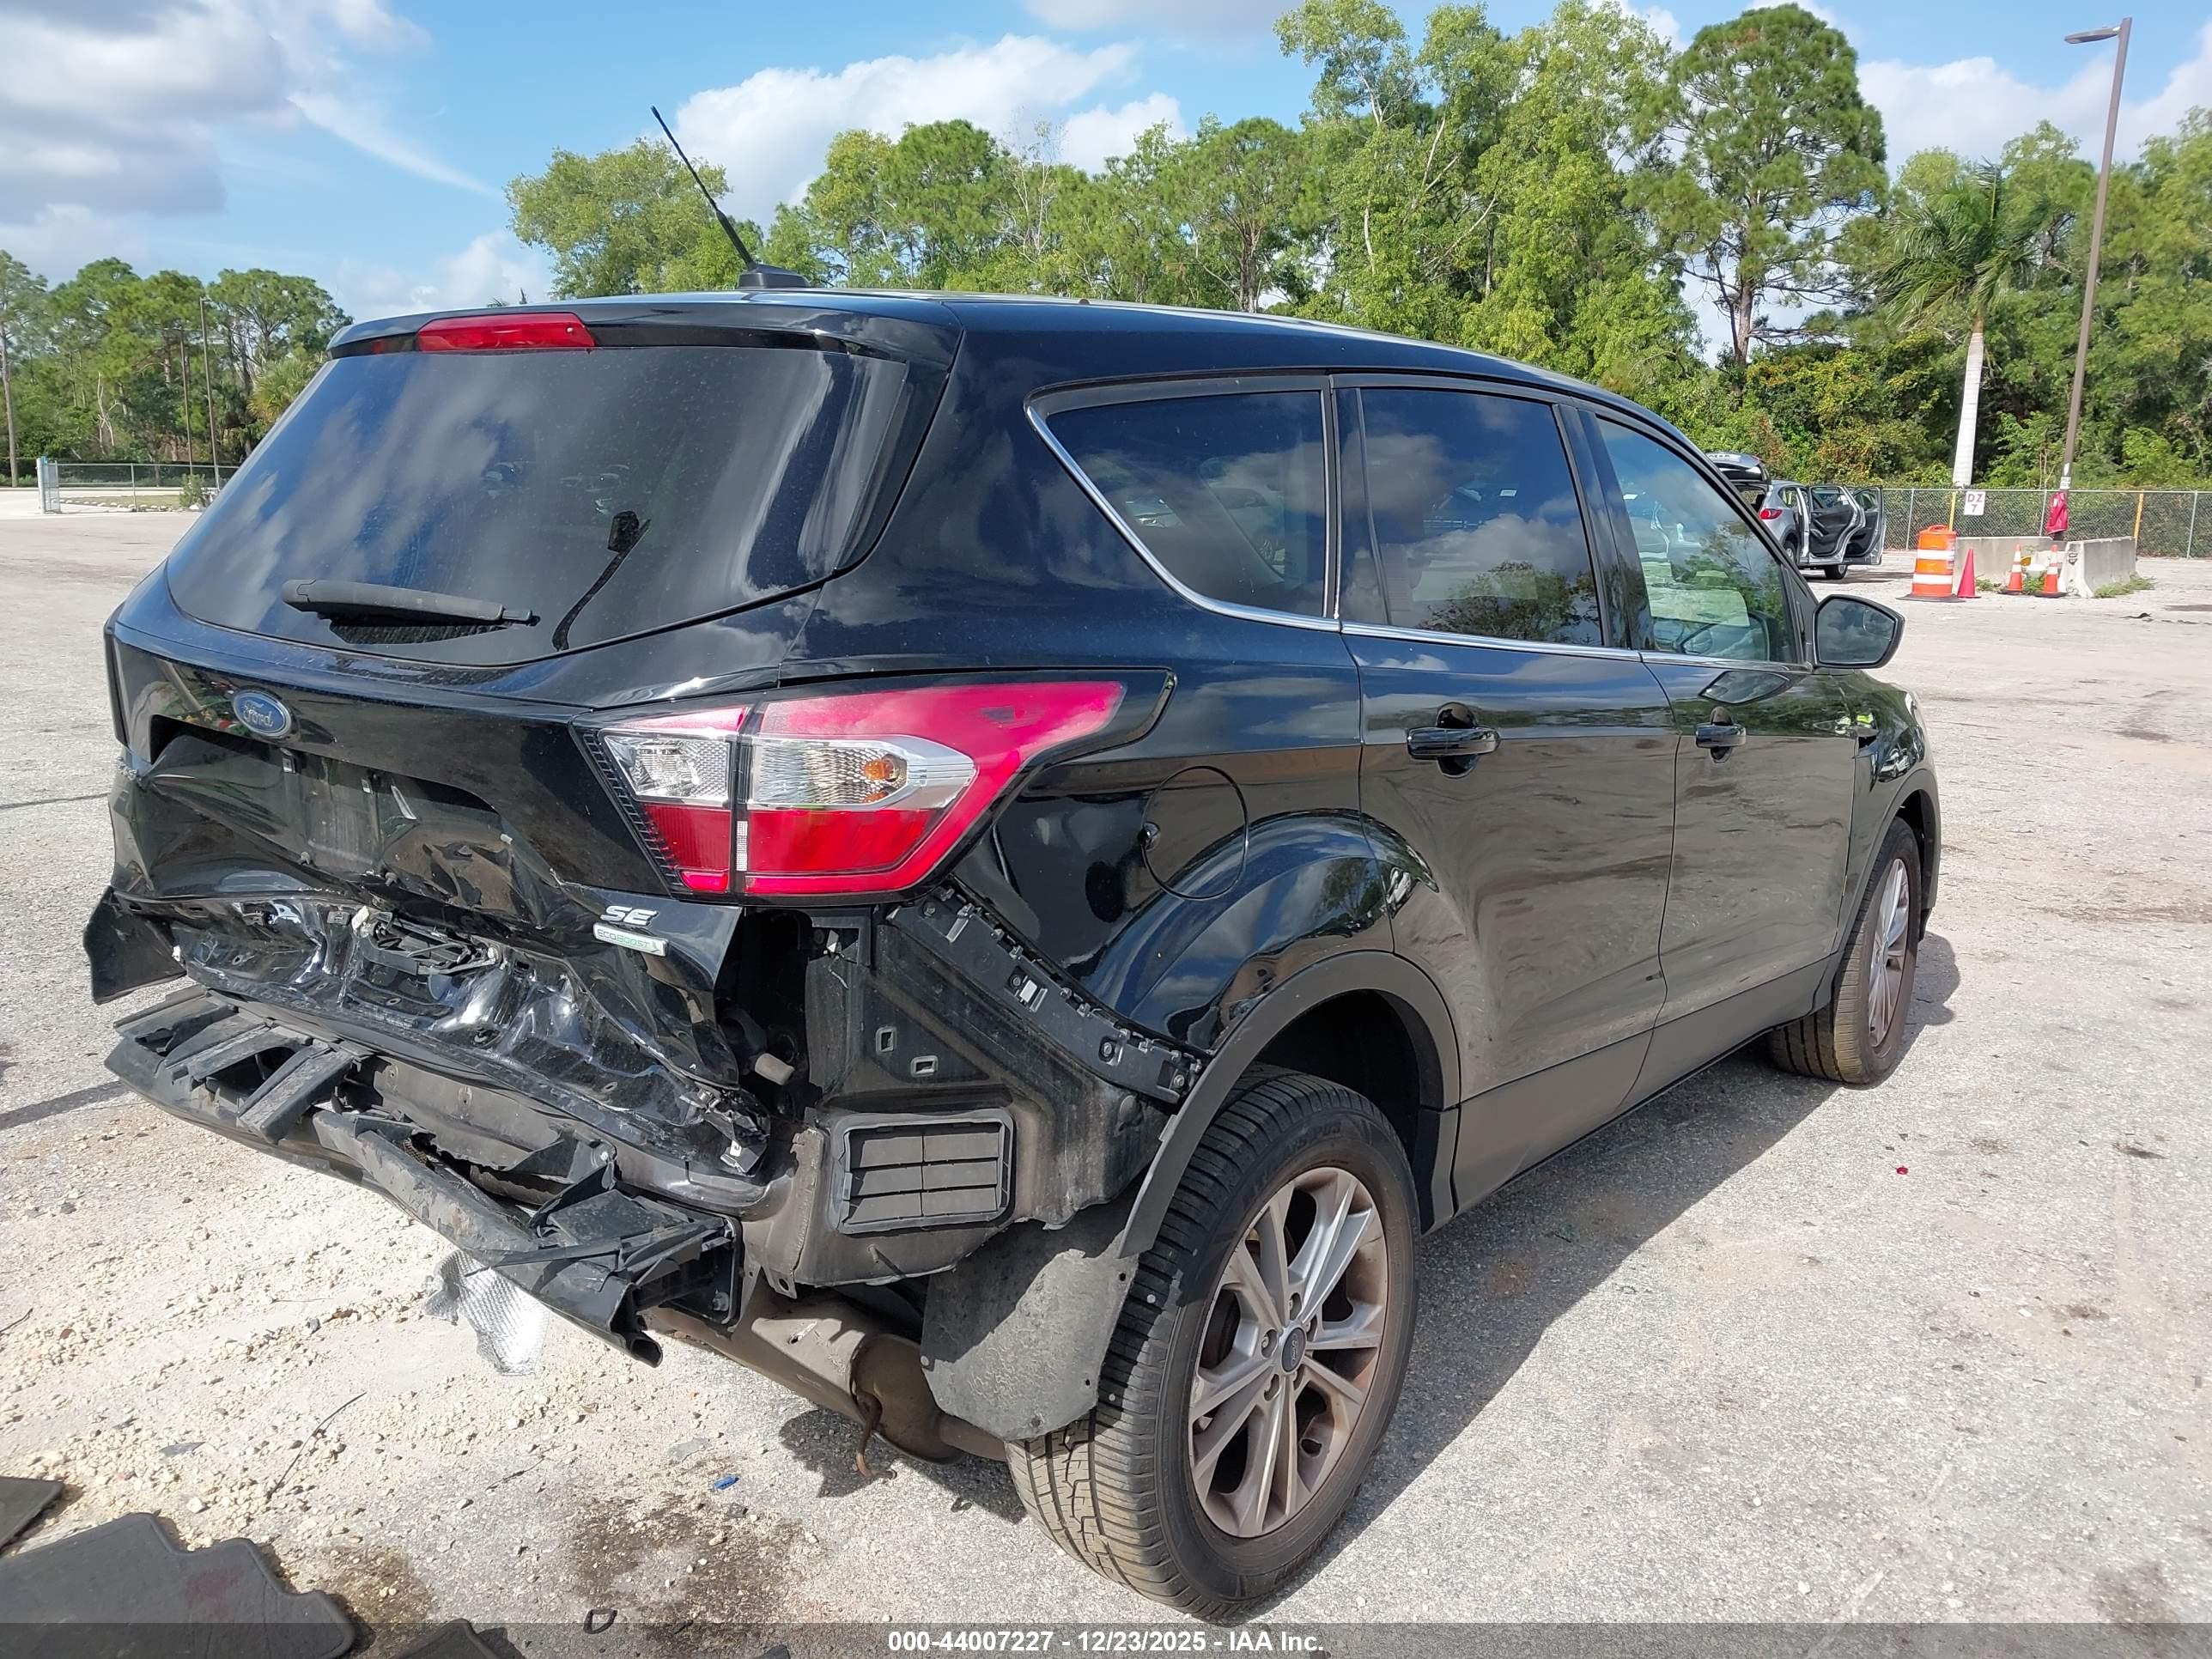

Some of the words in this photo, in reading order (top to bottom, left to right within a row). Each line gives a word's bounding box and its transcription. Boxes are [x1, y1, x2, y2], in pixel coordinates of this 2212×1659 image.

[241, 700, 275, 728] Ford
[600, 905, 659, 927] SE
[597, 928, 648, 948] ECOBOOST
